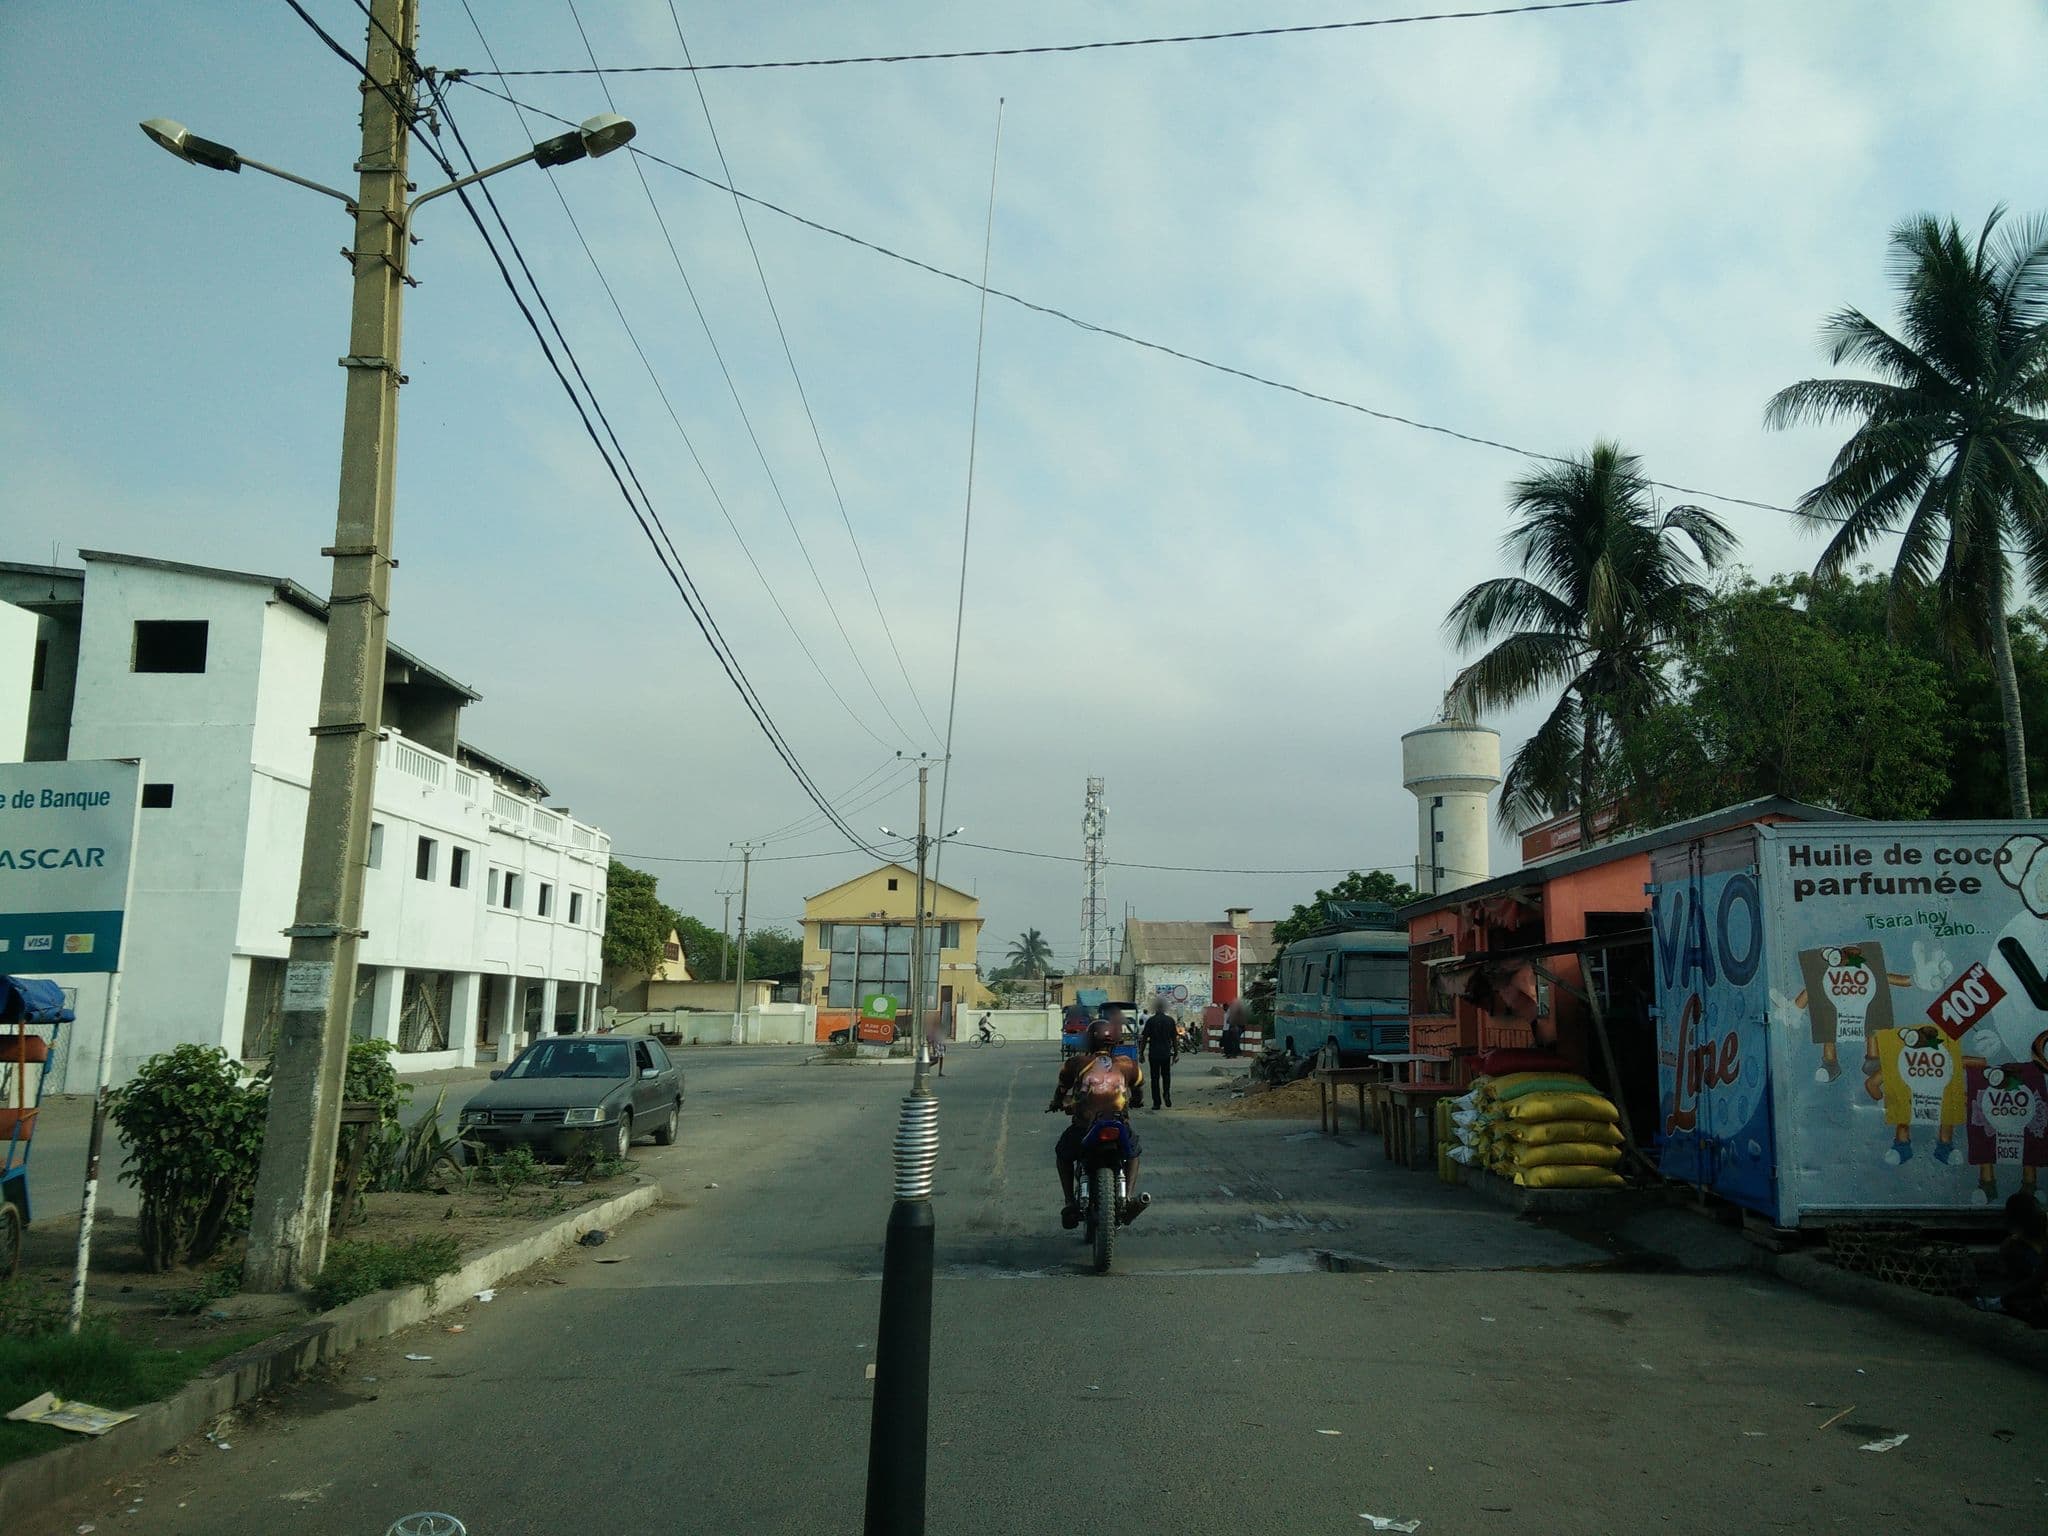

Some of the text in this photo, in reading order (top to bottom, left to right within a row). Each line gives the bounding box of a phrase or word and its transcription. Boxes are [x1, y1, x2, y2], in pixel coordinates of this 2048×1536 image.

[11, 789, 35, 809] de
[39, 788, 111, 811] Banque
[1788, 843, 2013, 867] Huile de coco
[1793, 870, 1982, 902] parfumée
[1865, 909, 1949, 930] Tsara hoy
[1652, 872, 1764, 990] VAO
[27, 937, 50, 948] VISA
[1828, 970, 1869, 985] VAO
[1831, 985, 1868, 996] COCO
[1665, 992, 1740, 1137] Line
[1904, 1051, 1945, 1068] VAO
[1908, 1067, 1944, 1078] COCO
[1988, 1091, 2029, 1107] VAO
[1991, 1106, 2027, 1117] COCO
[1997, 1146, 2019, 1159] ROSE
